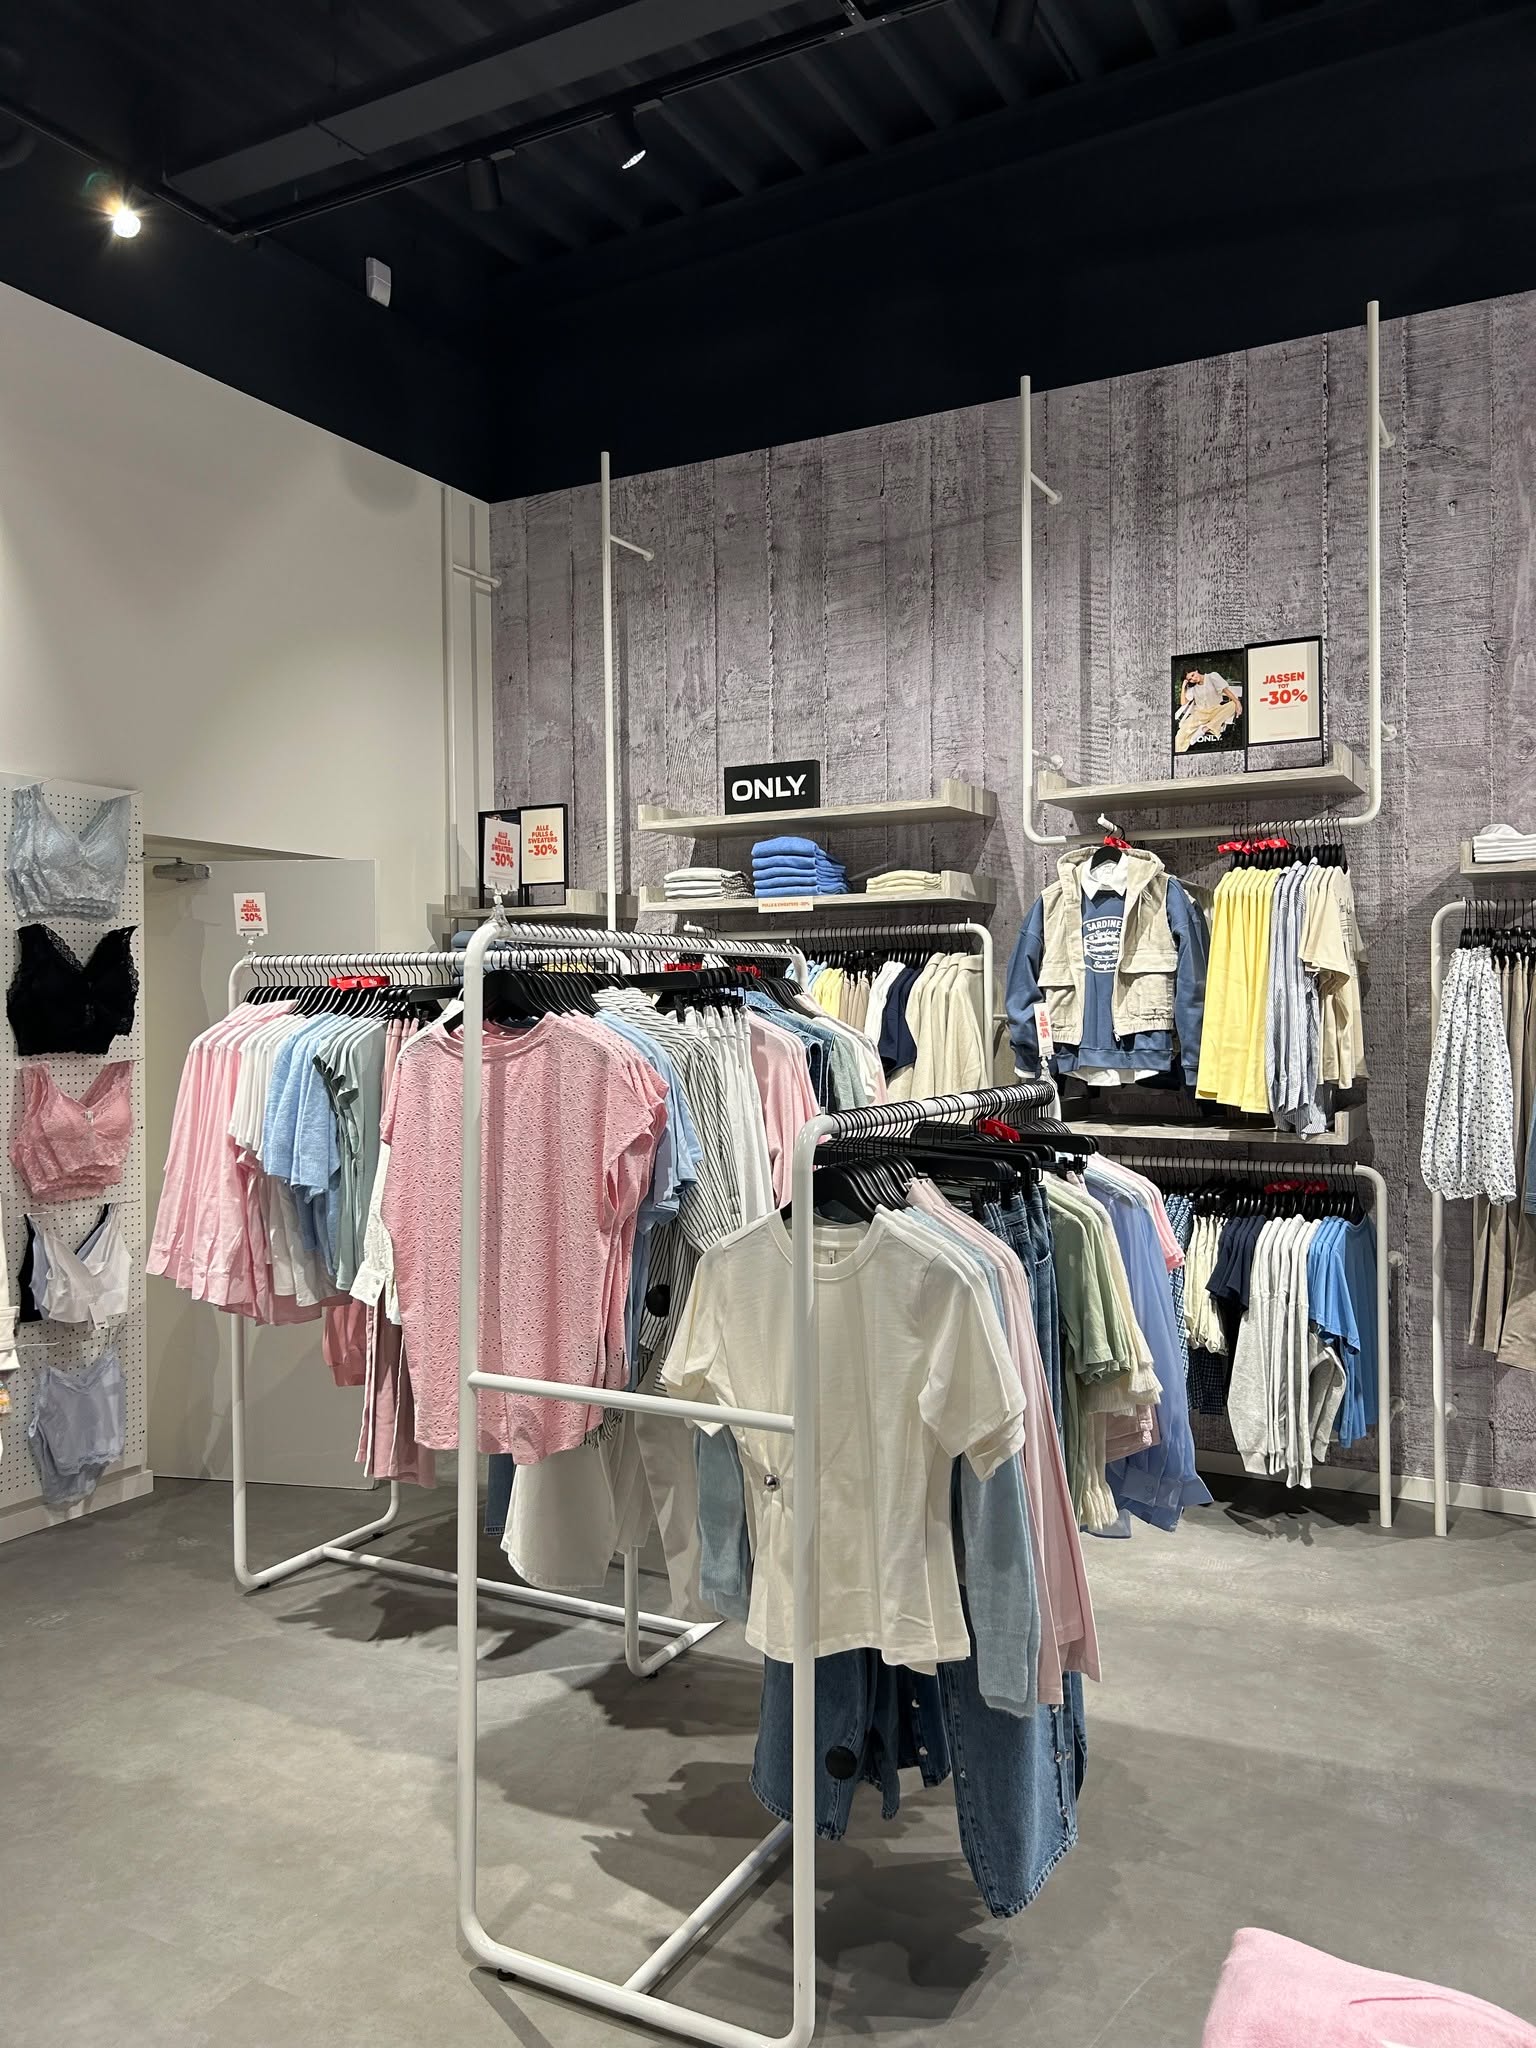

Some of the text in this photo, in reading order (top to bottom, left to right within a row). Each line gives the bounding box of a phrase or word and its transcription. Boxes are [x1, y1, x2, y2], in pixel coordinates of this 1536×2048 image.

[1262, 671, 1305, 685] JASSEN
[1259, 688, 1308, 705] -30%
[535, 824, 550, 832] ALLE
[527, 836, 558, 845] SWEATERS
[528, 844, 558, 856] -30%
[490, 852, 514, 868] -30%
[240, 912, 263, 922] -30%
[1086, 919, 1122, 931] SARDINE
[1093, 960, 1116, 971] Seafoo
